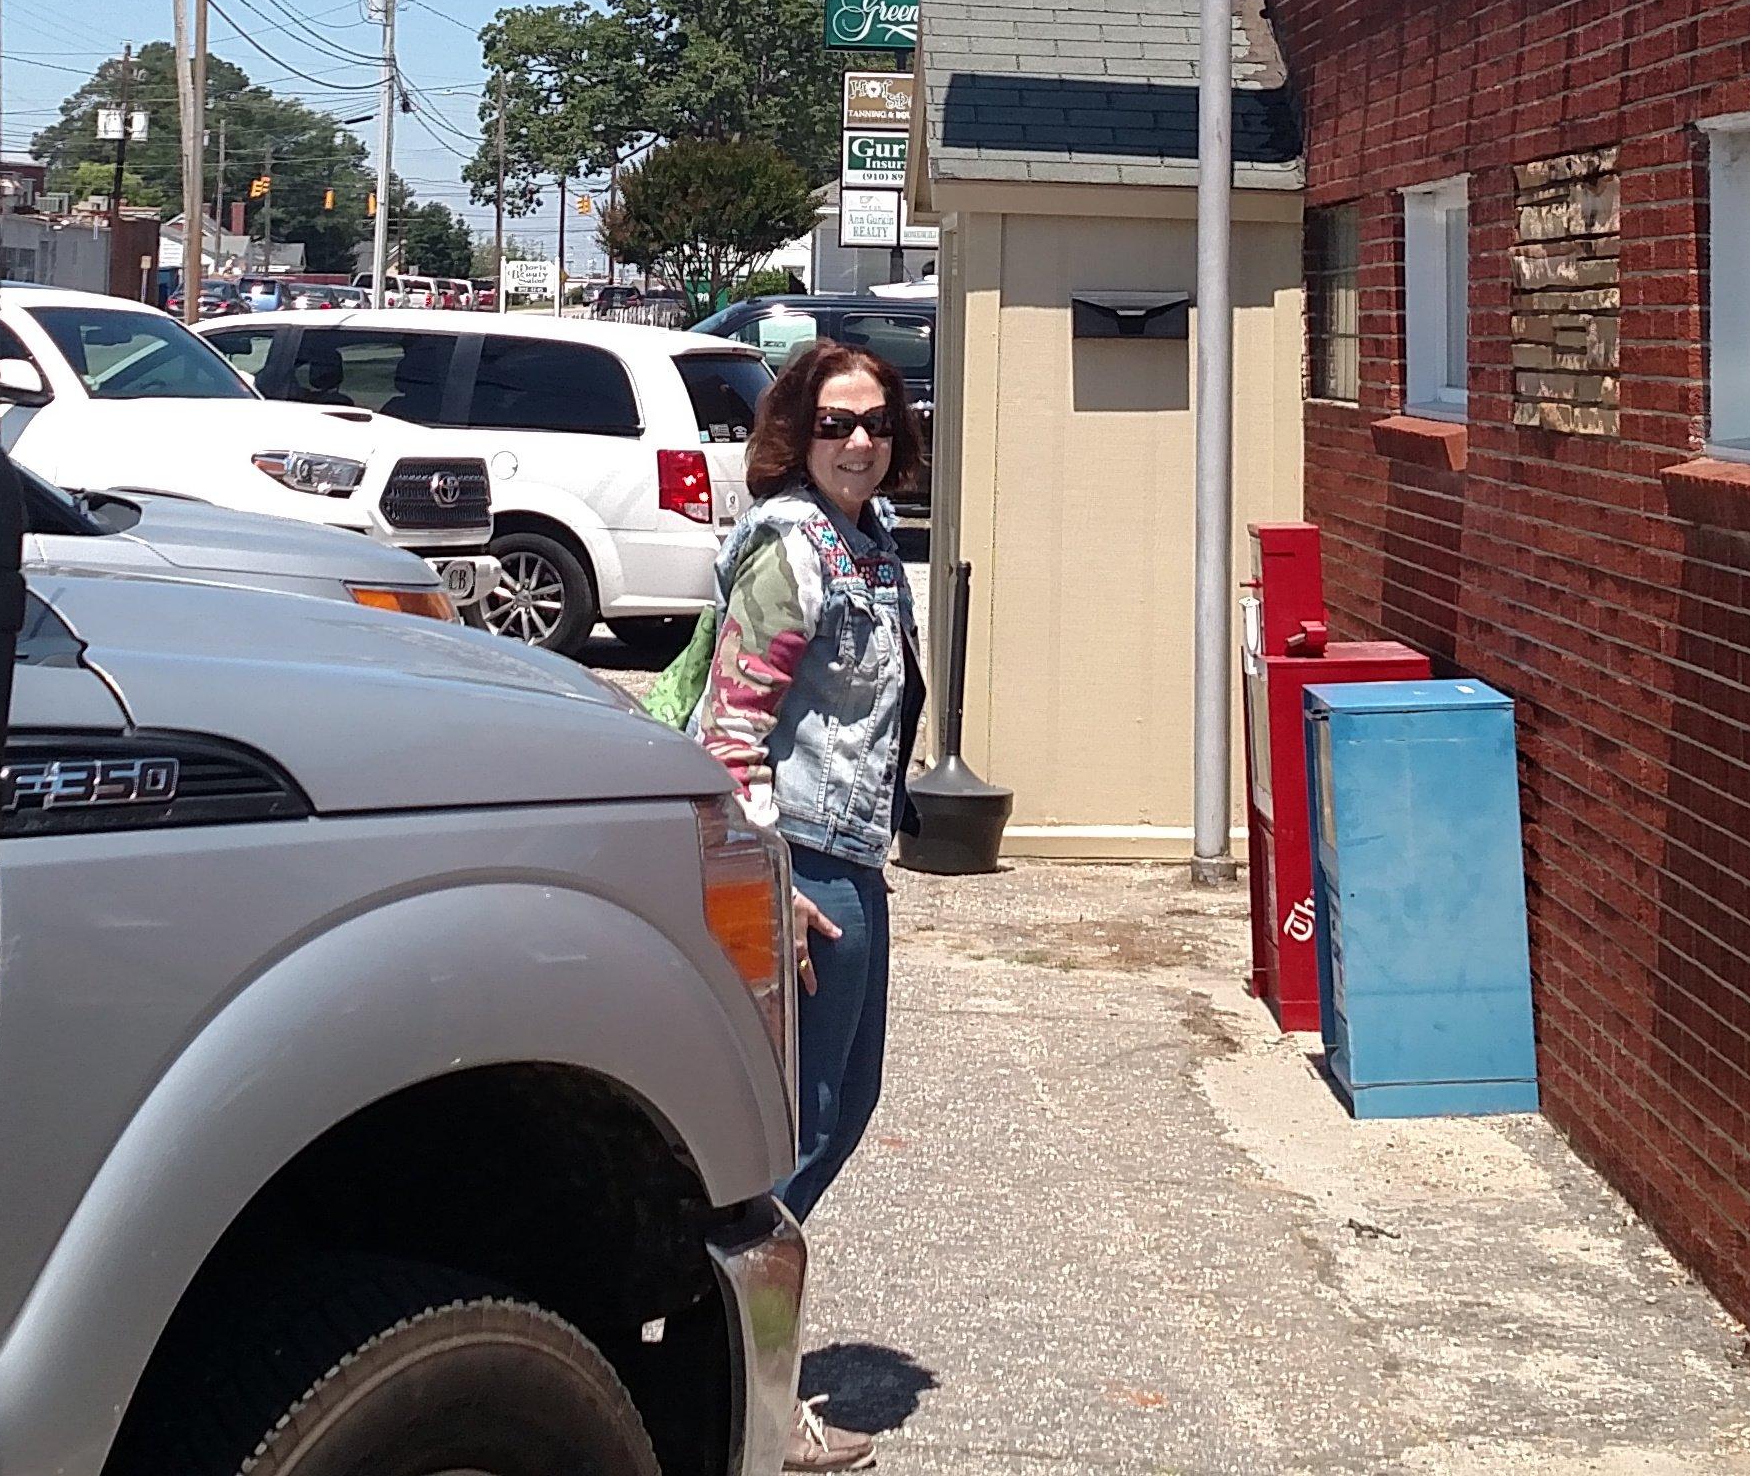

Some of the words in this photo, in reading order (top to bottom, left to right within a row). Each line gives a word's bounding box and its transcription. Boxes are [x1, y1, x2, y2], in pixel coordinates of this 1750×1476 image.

[862, 172, 889, 181] (910)
[853, 226, 888, 238] REALTY
[449, 569, 467, 590] CB
